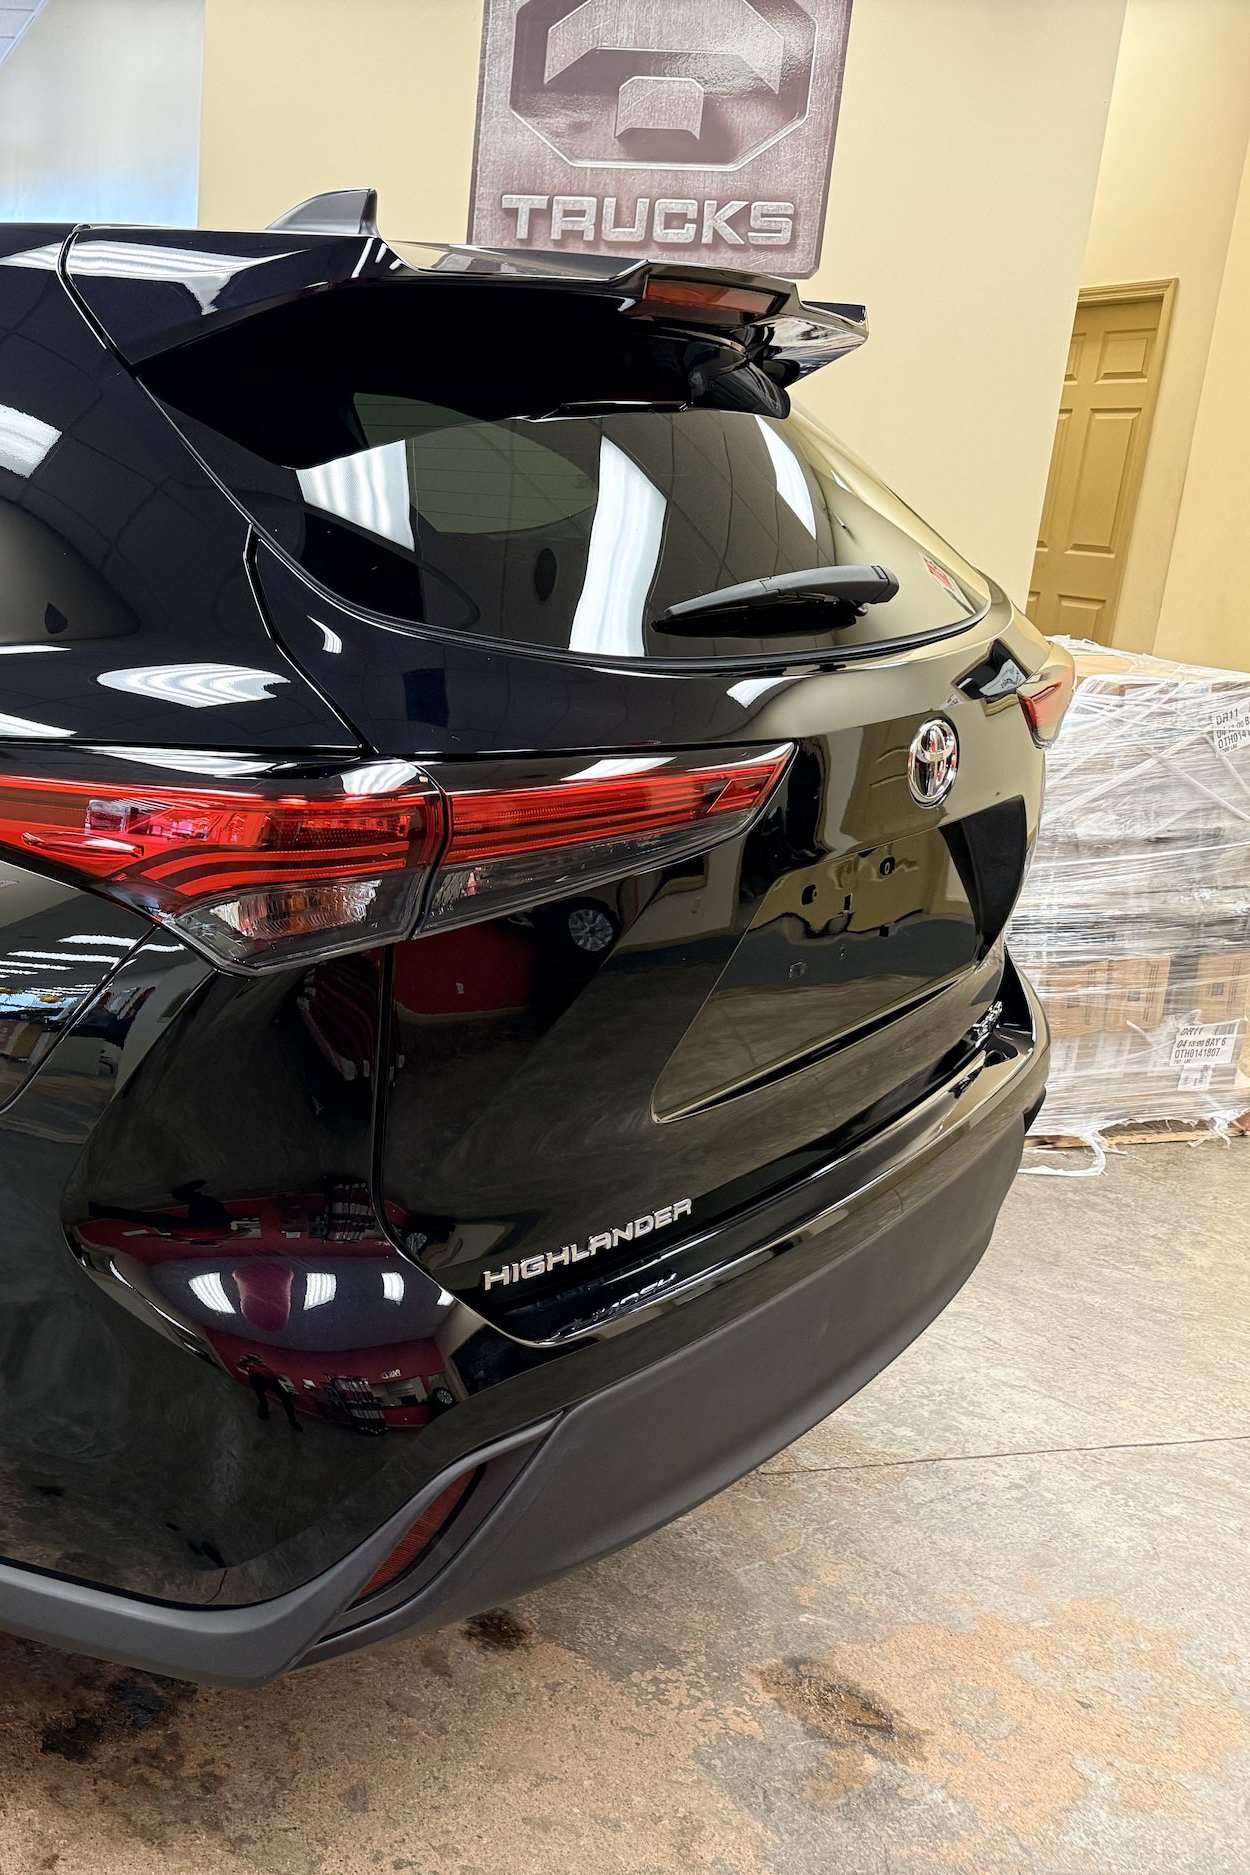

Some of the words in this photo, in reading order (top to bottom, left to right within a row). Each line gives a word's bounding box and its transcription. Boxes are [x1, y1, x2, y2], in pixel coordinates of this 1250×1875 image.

[502, 193, 795, 247] TRUCKS
[1205, 1038, 1221, 1047] BAY
[482, 1197, 693, 1292] HIGHLANDER
